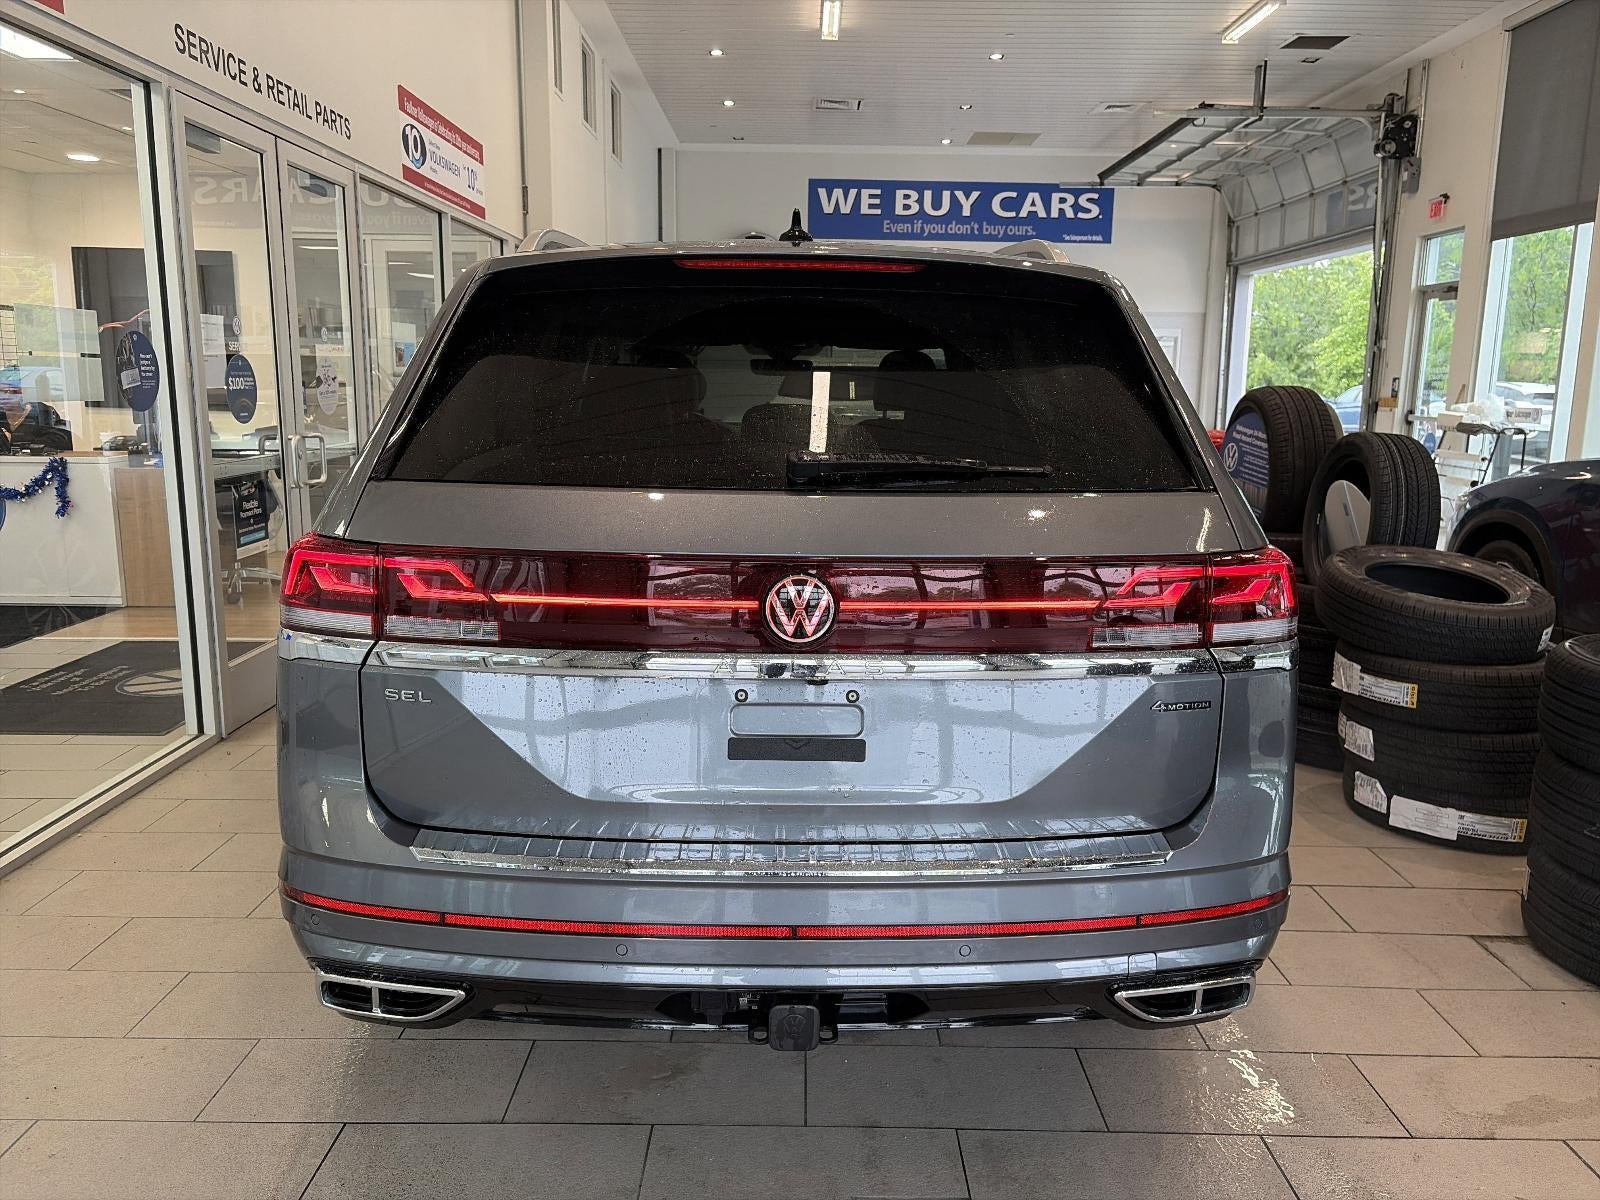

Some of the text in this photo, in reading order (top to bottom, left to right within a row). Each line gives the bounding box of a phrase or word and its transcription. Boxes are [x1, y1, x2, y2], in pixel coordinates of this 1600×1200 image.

[174, 23, 351, 140] SERVICE & RETAIL PARTS
[429, 150, 461, 178] VOLKSWAGEN
[818, 187, 882, 215] WE
[895, 189, 981, 217] BUY
[883, 220, 1036, 238] Even if you don't buy ours.
[228, 378, 244, 390] $100
[385, 688, 432, 703] SEL
[1151, 700, 1210, 711] 4MOTION
